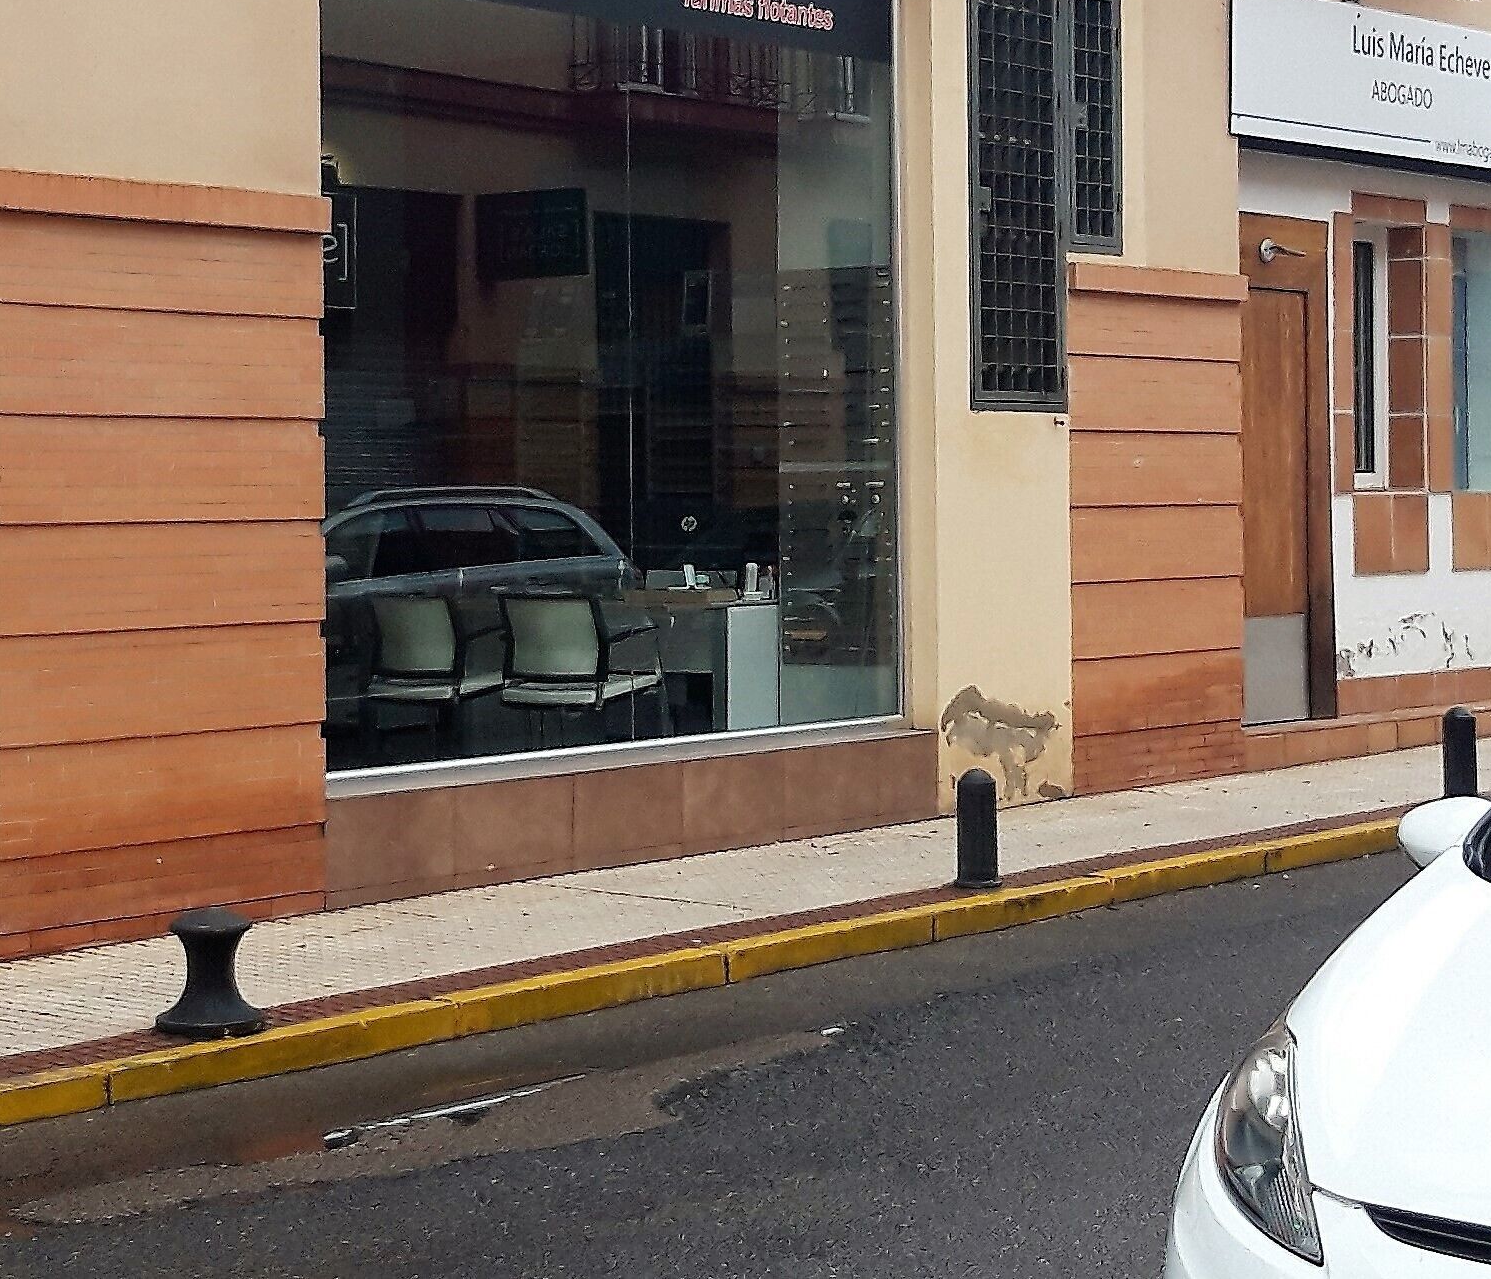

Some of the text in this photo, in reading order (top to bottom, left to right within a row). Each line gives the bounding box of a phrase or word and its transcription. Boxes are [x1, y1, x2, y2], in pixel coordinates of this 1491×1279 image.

[1352, 25, 1385, 58] Luis
[1389, 31, 1434, 67] María
[1371, 79, 1433, 110] ABOGADO
